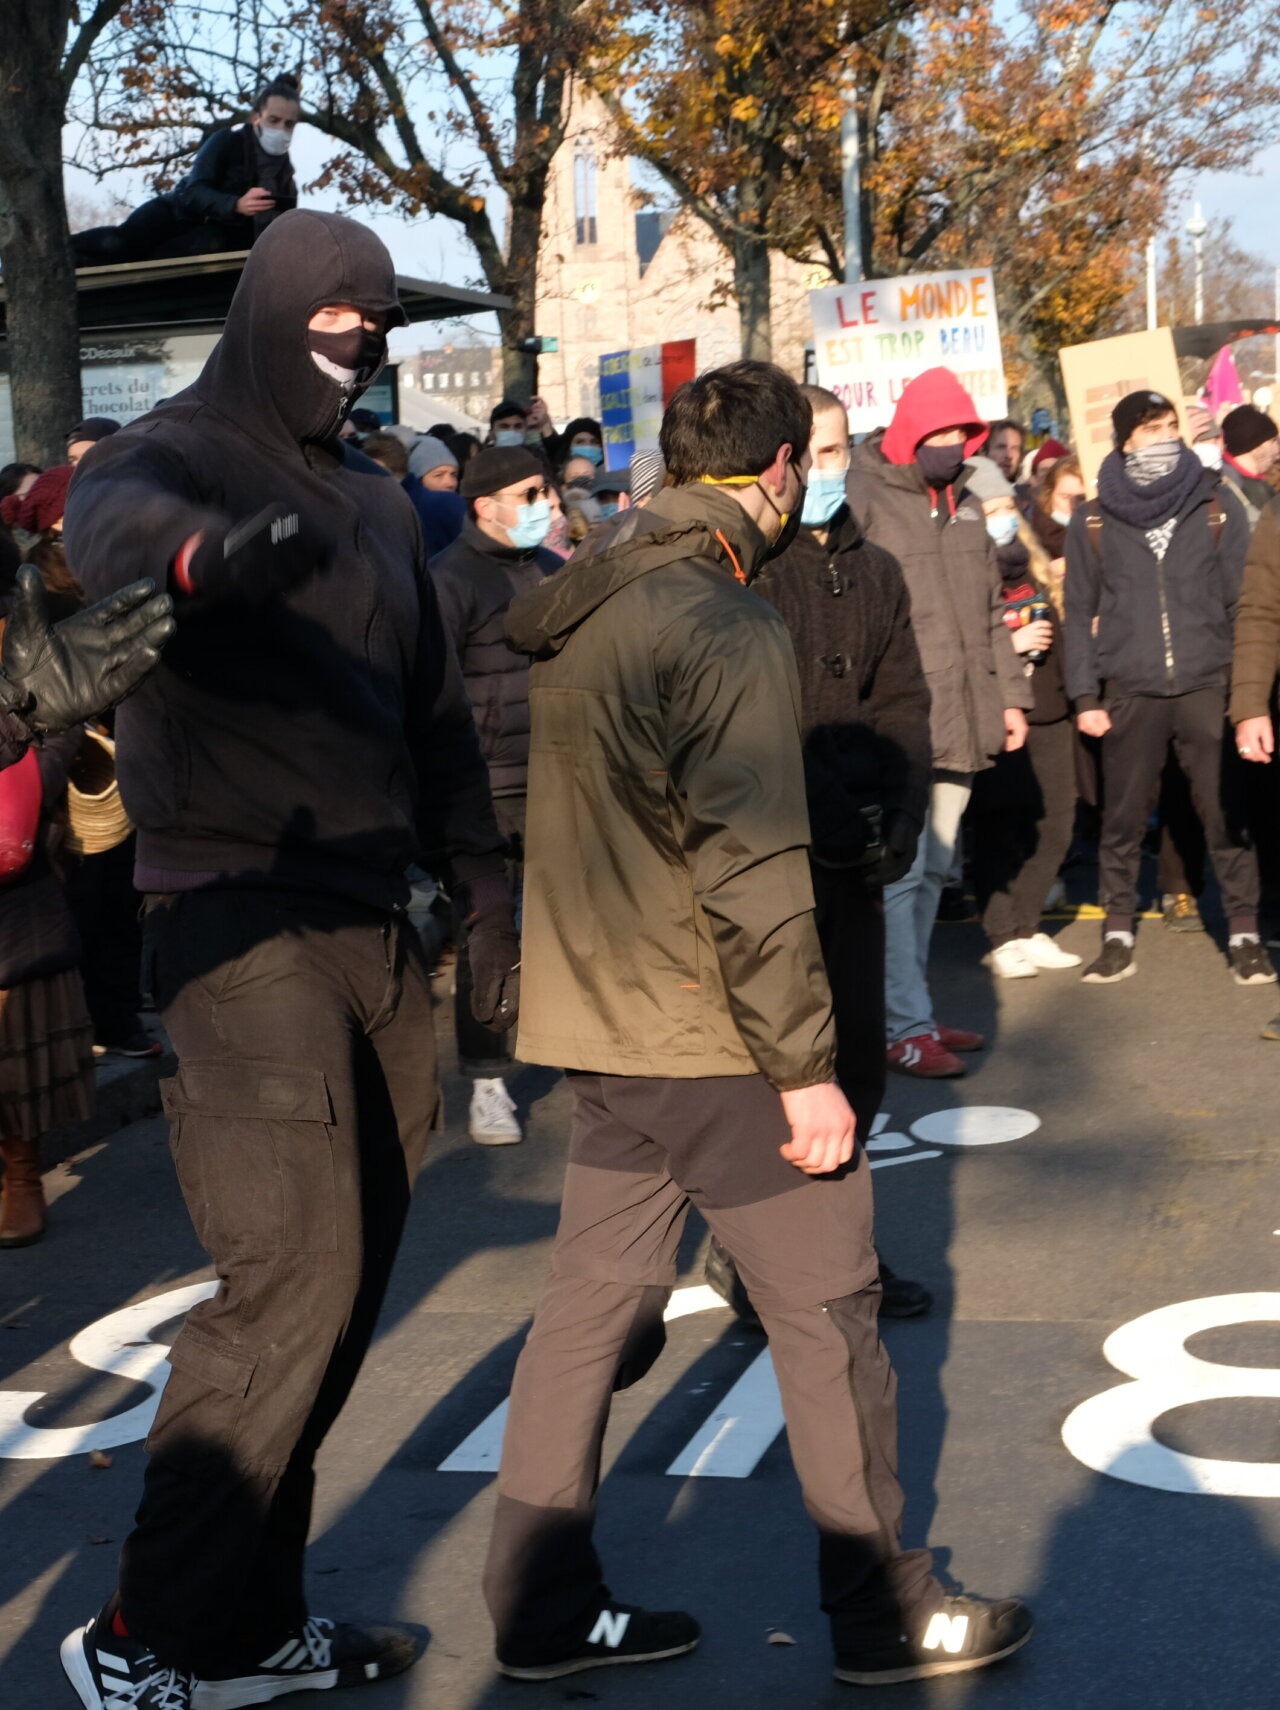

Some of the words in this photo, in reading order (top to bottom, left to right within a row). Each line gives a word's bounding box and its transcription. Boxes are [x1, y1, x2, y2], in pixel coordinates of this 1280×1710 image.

[836, 291, 879, 328] LE
[899, 276, 988, 322] MONDE
[825, 336, 864, 366] EST
[875, 330, 925, 361] TROP
[128, 378, 149, 394] du
[83, 397, 150, 414] hocolat
[586, 1609, 631, 1648] N
[921, 1612, 969, 1653] N
